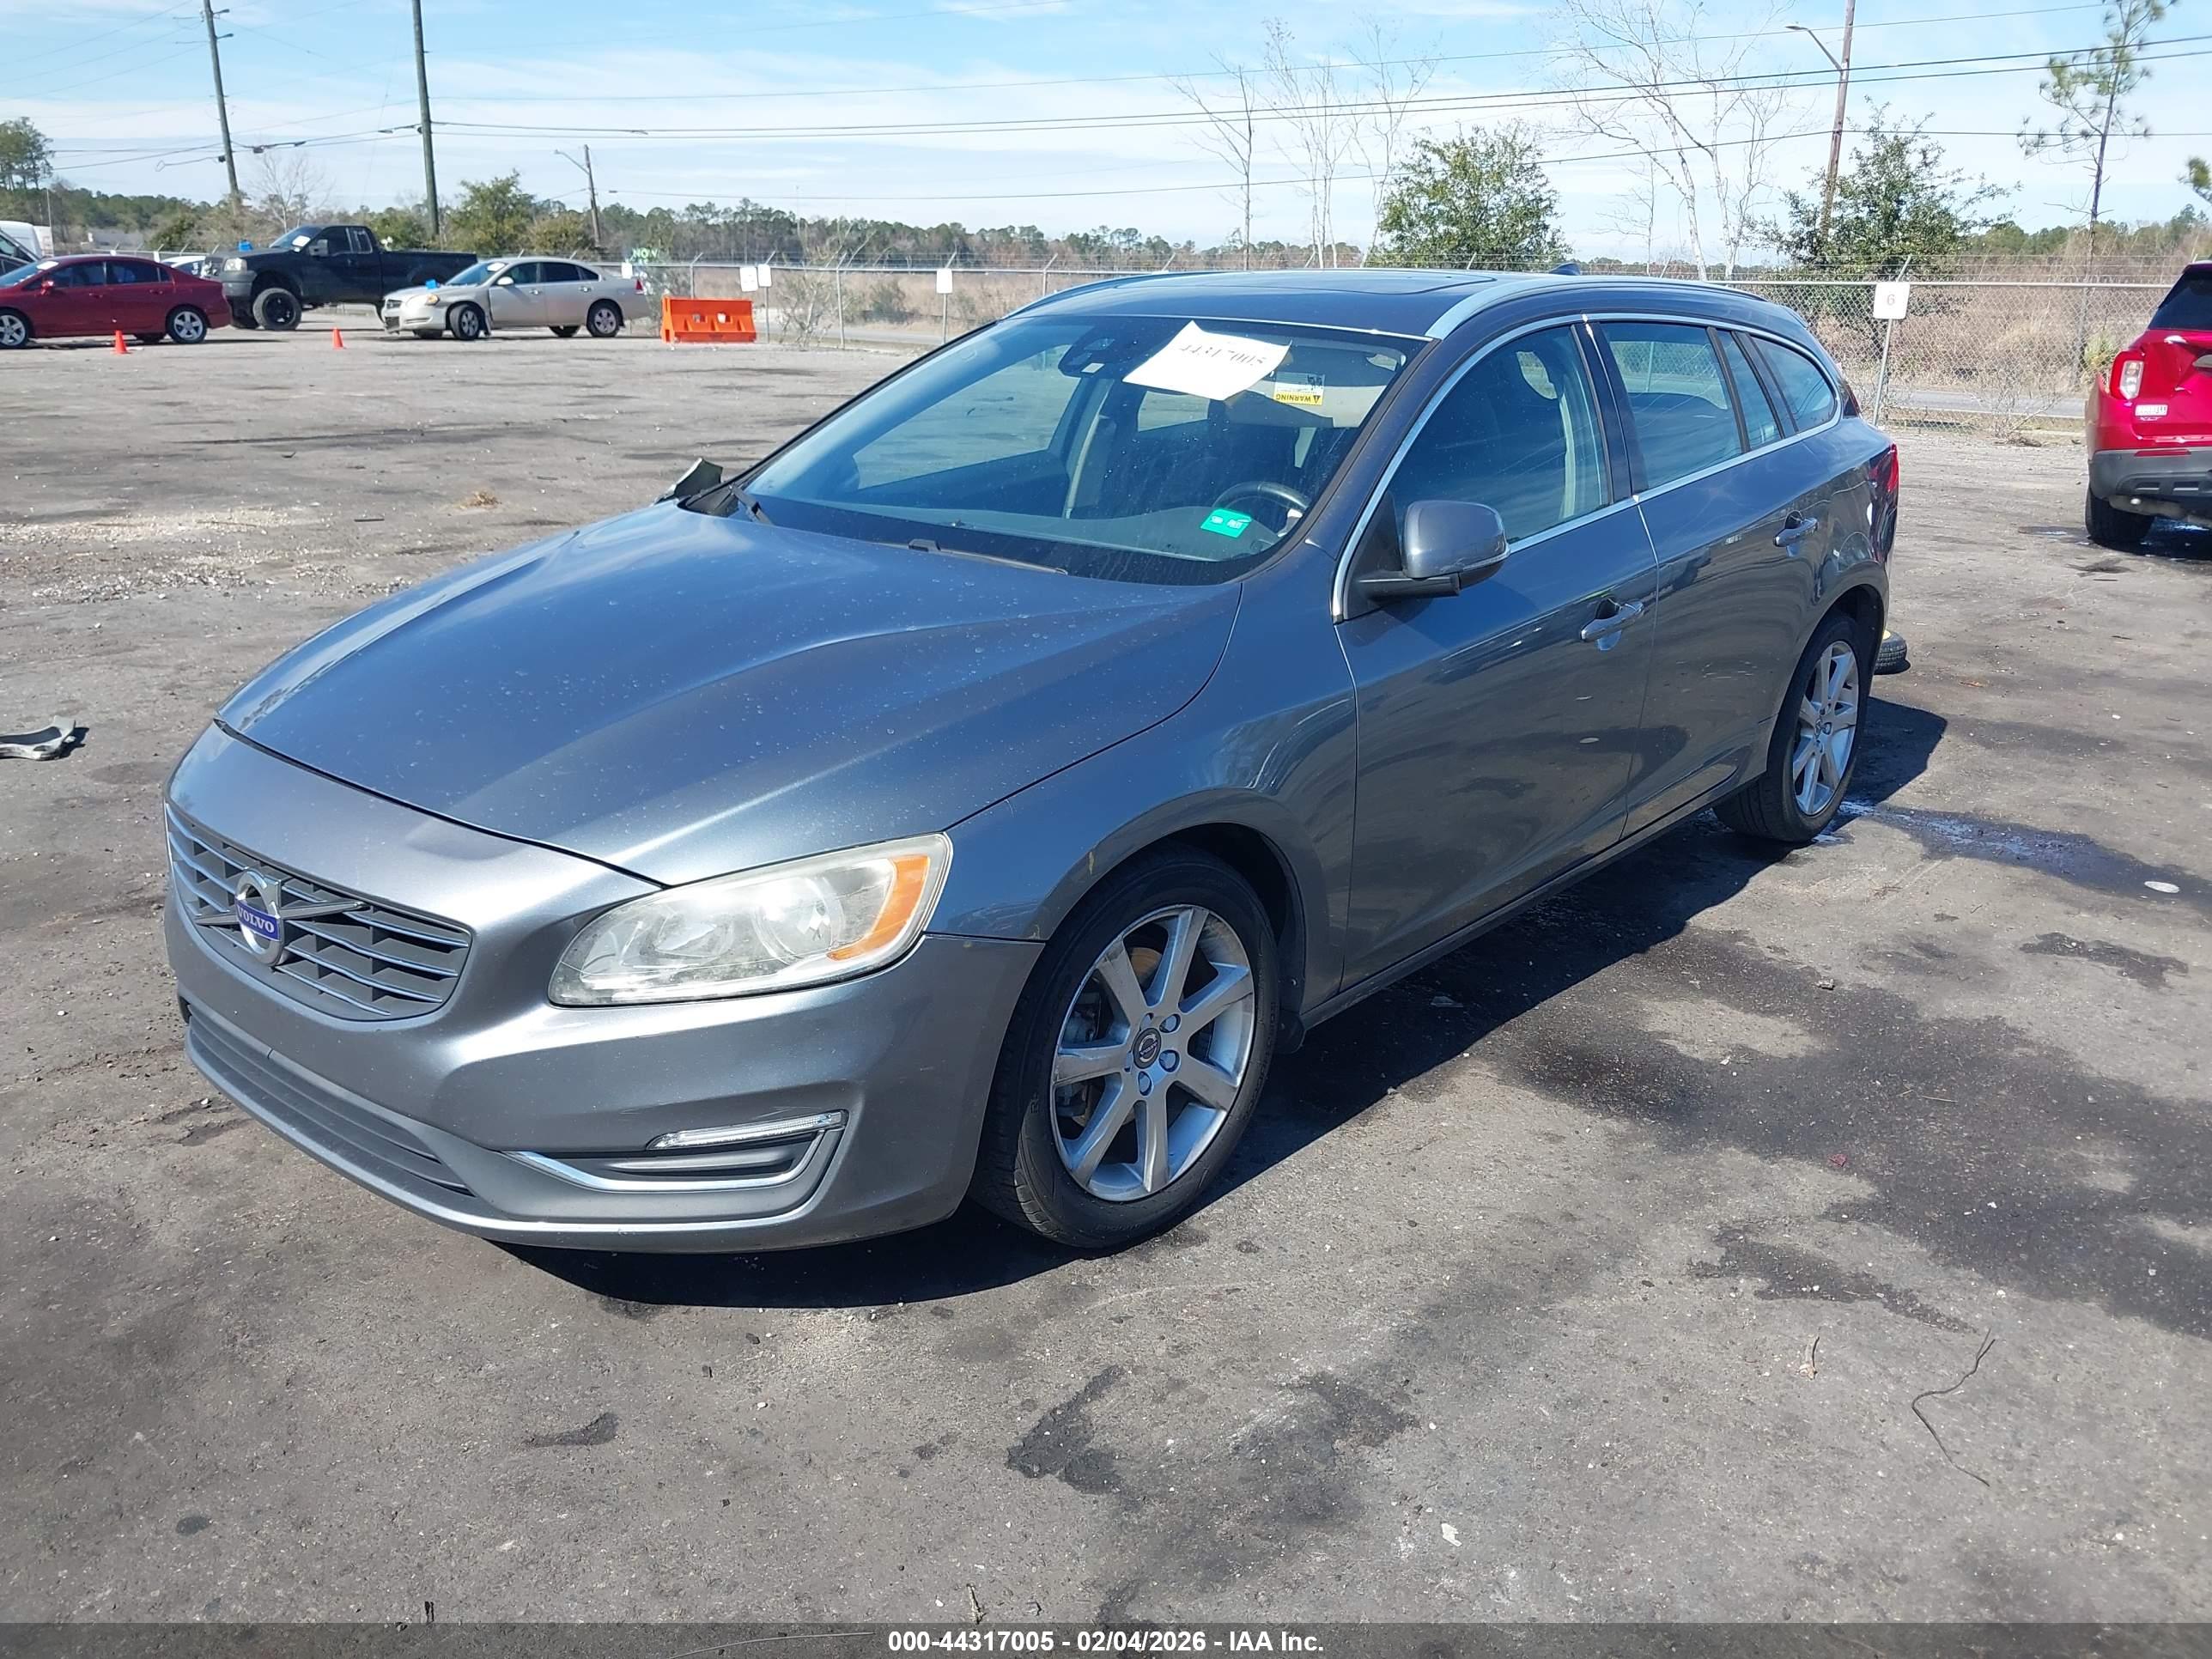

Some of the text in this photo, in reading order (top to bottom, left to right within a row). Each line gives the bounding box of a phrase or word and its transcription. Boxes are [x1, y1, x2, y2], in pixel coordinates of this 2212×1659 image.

[1887, 294, 1895, 306] 6
[1276, 393, 1311, 404] WARNING
[237, 904, 275, 933] VOLVO
